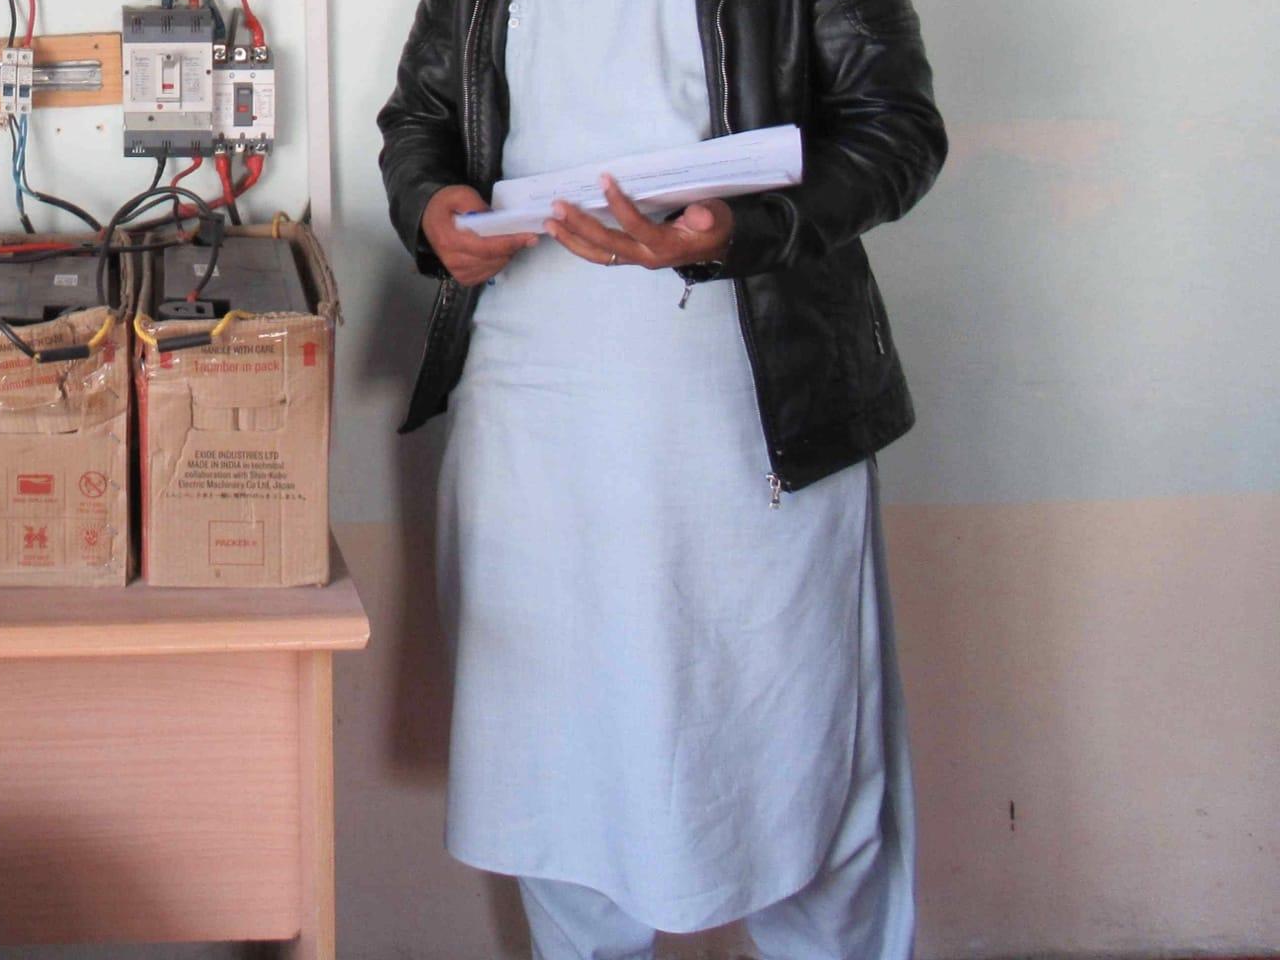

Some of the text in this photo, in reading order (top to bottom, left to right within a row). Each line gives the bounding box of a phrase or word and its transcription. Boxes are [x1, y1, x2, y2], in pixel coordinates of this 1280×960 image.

[233, 344, 254, 354] WITH
[255, 343, 275, 353] CARE
[200, 360, 239, 373] number
[242, 363, 251, 373] in
[255, 360, 280, 374] pack
[195, 450, 279, 460] EXIDE INDUSTRIES LTD
[188, 460, 208, 468] MADE
[210, 460, 219, 468] IN
[221, 460, 241, 468] INDIA
[185, 470, 232, 478] collaboration
[233, 470, 248, 478] with
[178, 479, 205, 488] Electric
[207, 479, 244, 489] Machinery
